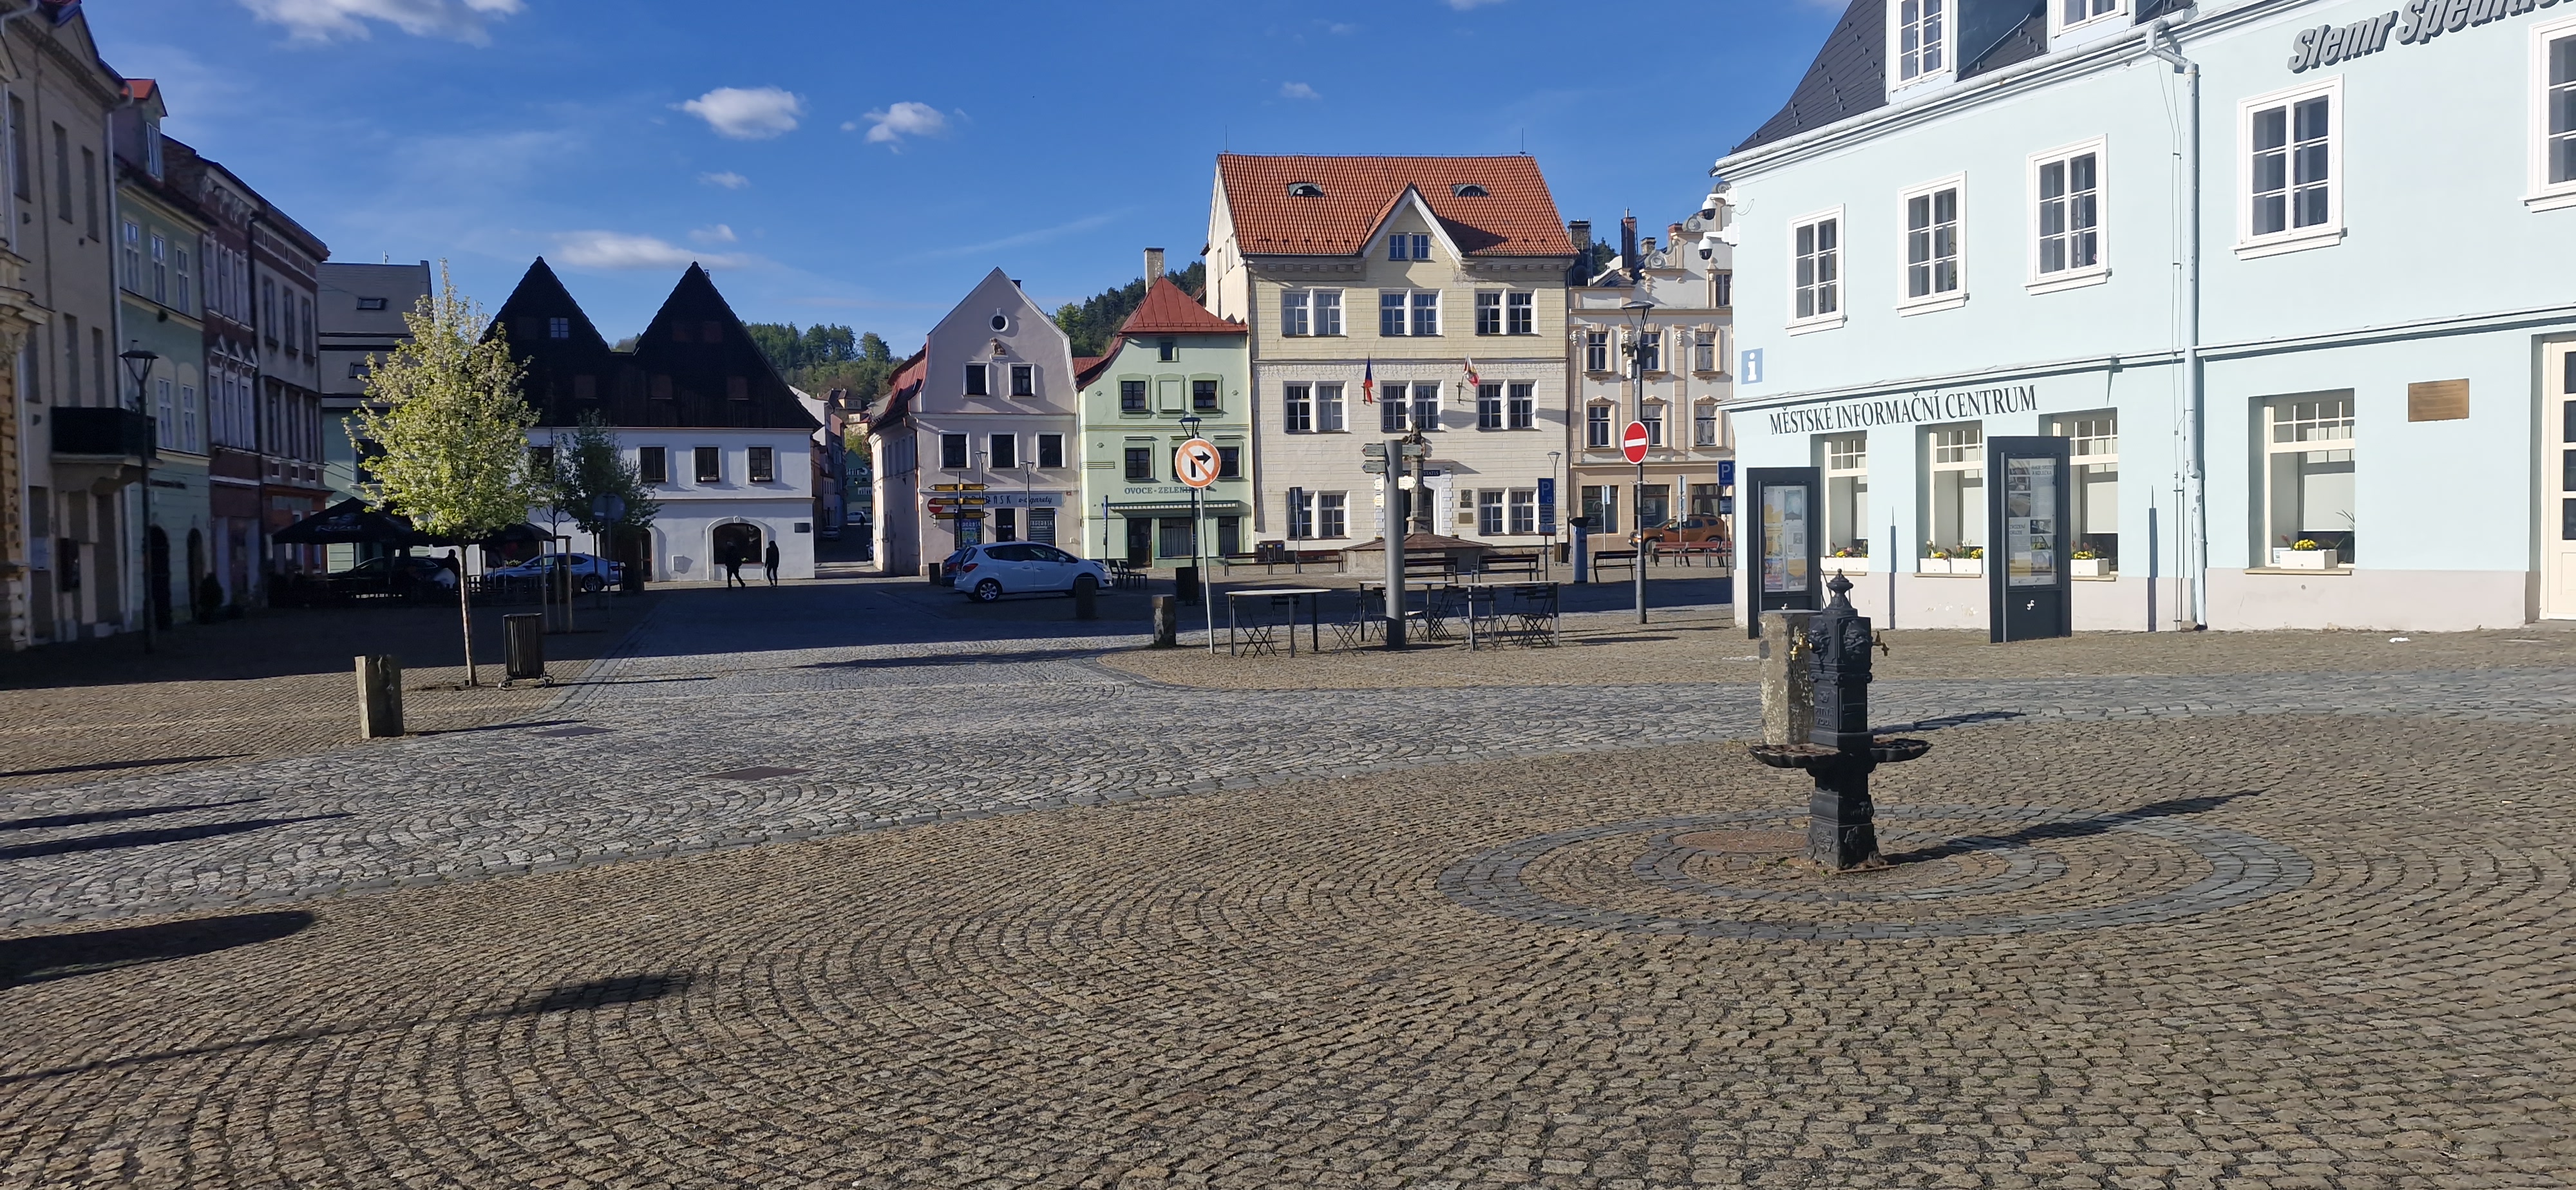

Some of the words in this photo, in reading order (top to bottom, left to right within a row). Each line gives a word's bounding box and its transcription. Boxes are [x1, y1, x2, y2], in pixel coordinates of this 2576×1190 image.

[2287, 10, 2398, 73] Slemr
[1747, 352, 1757, 381] i
[1769, 402, 1834, 435] MĚSTSKÉ
[1836, 390, 1942, 428] INFORMAČNÍ
[1945, 384, 2038, 419] CENTRUM
[1721, 464, 1730, 478] P
[1542, 481, 1550, 496] P
[1018, 496, 1052, 504] e-cgarety
